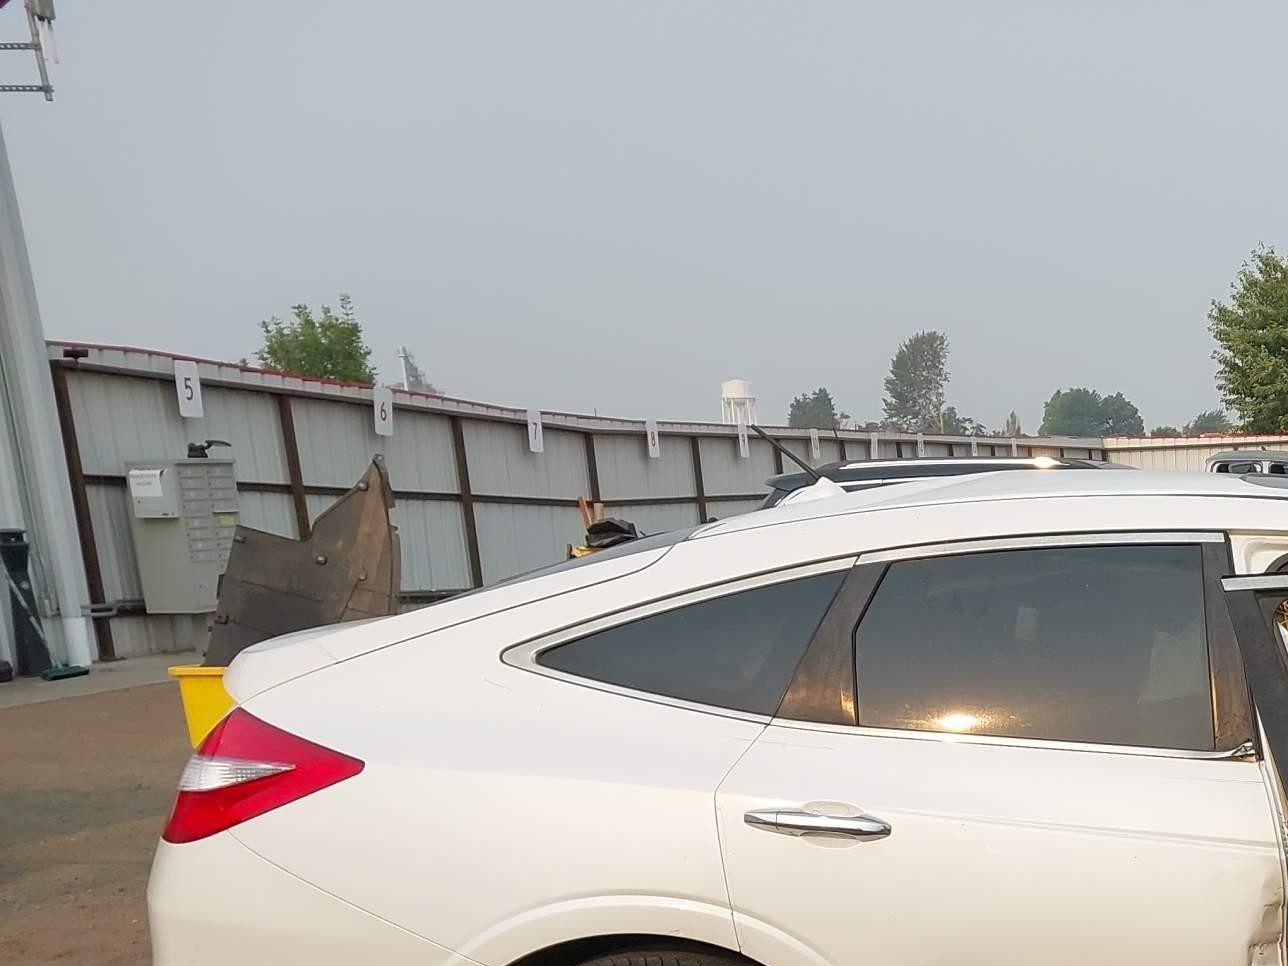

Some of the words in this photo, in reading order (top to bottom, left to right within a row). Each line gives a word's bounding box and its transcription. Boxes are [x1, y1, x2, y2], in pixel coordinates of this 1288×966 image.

[184, 377, 194, 401] 5
[380, 402, 387, 421] 6
[532, 422, 538, 441] 7
[650, 431, 656, 448] 8
